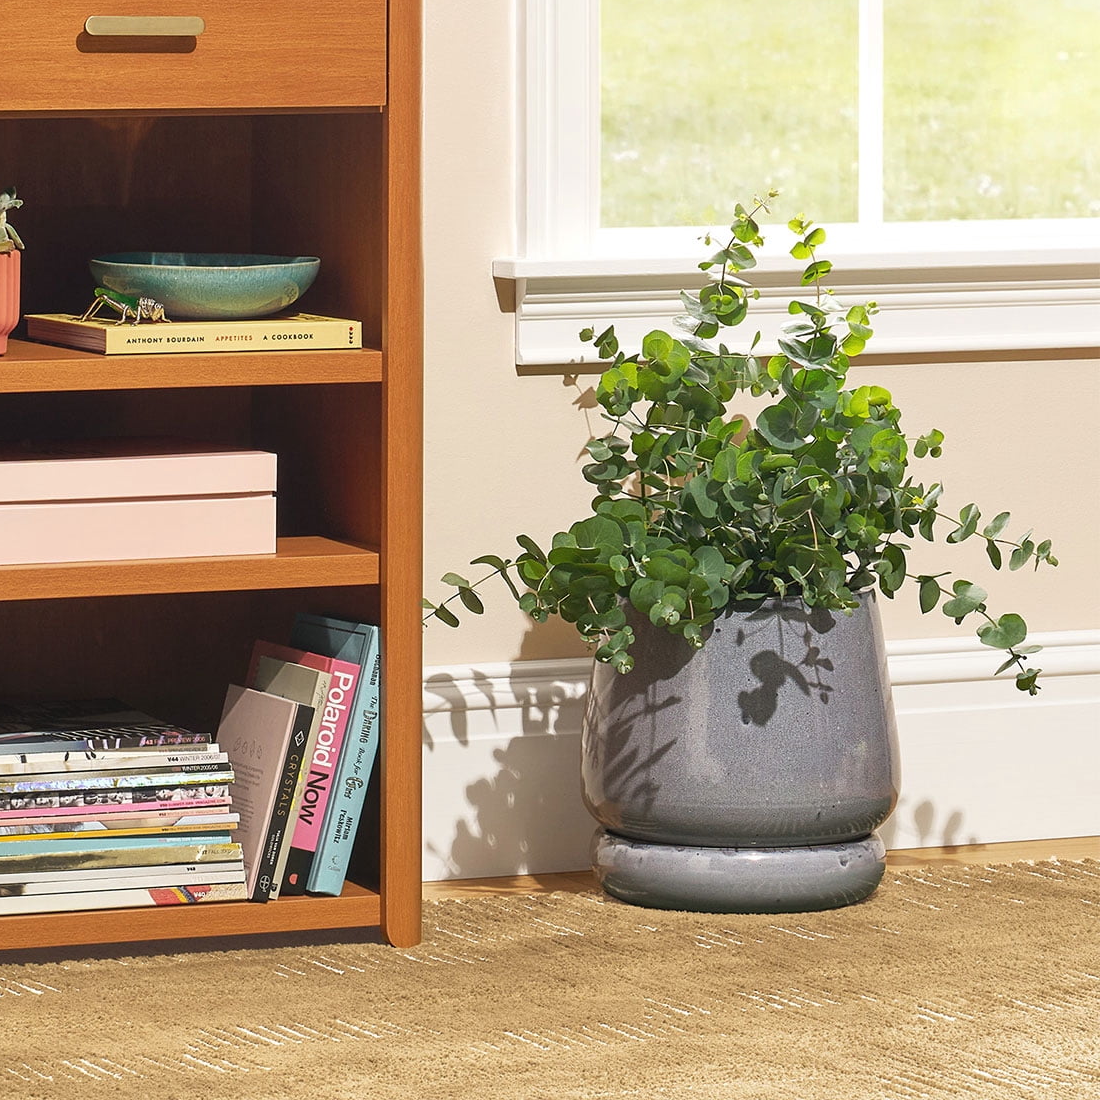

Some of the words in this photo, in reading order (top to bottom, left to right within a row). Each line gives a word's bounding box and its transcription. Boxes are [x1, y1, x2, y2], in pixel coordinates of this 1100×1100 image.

[312, 670, 354, 768] Polaroid
[370, 696, 378, 708] The
[276, 754, 299, 817] CRYSTALS
[298, 770, 330, 826] Now
[342, 816, 353, 841] Miriam
